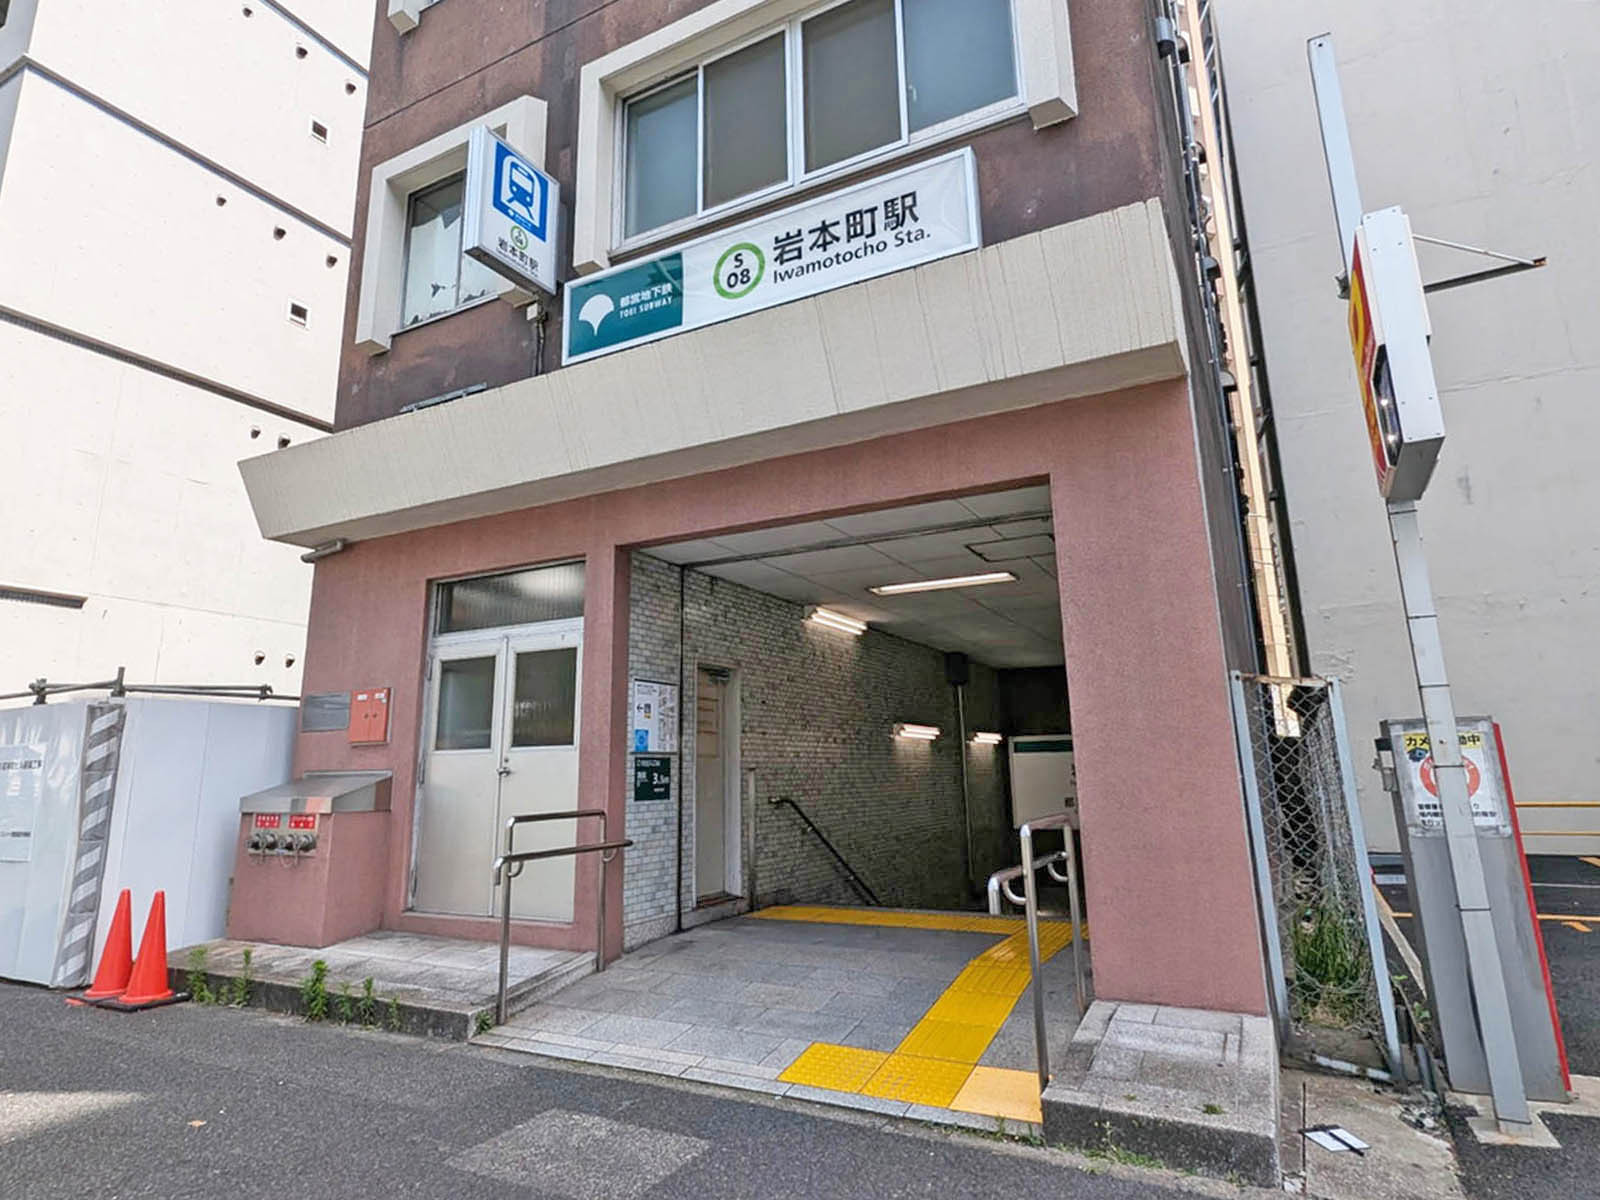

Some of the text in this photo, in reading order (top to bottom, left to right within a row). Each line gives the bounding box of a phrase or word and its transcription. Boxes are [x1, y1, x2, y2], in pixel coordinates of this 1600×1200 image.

[773, 191, 919, 266] 岩本町駅
[734, 253, 743, 268] S
[773, 227, 932, 284] Iwamotocho Sta.
[727, 268, 751, 289] 08
[639, 296, 672, 312] SUBWAY
